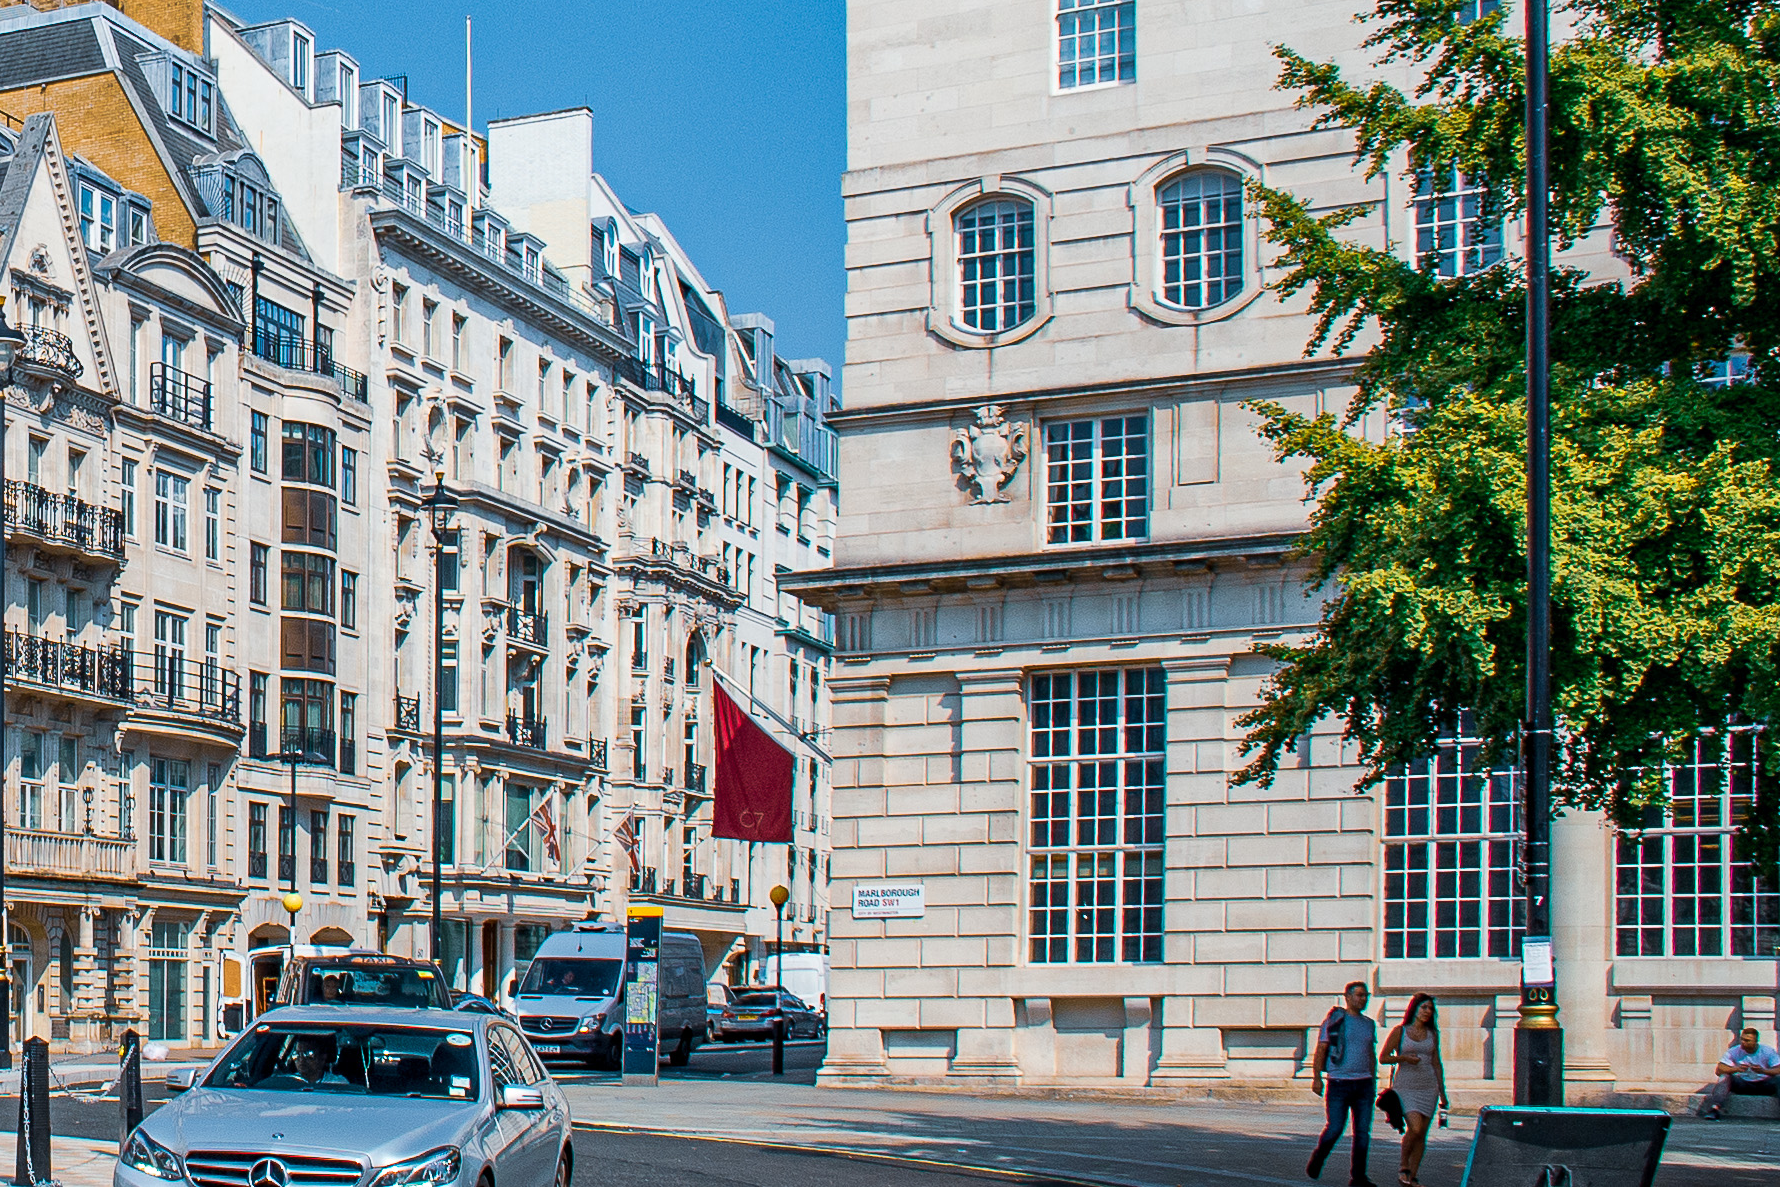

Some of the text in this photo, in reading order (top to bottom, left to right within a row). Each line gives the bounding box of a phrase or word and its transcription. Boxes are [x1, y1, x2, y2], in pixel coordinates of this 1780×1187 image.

[857, 888, 920, 898] MARLBOROUGH
[858, 898, 899, 908] ROAD SW1
[1533, 895, 1544, 906] 7
[362, 956, 389, 965] TAXI
